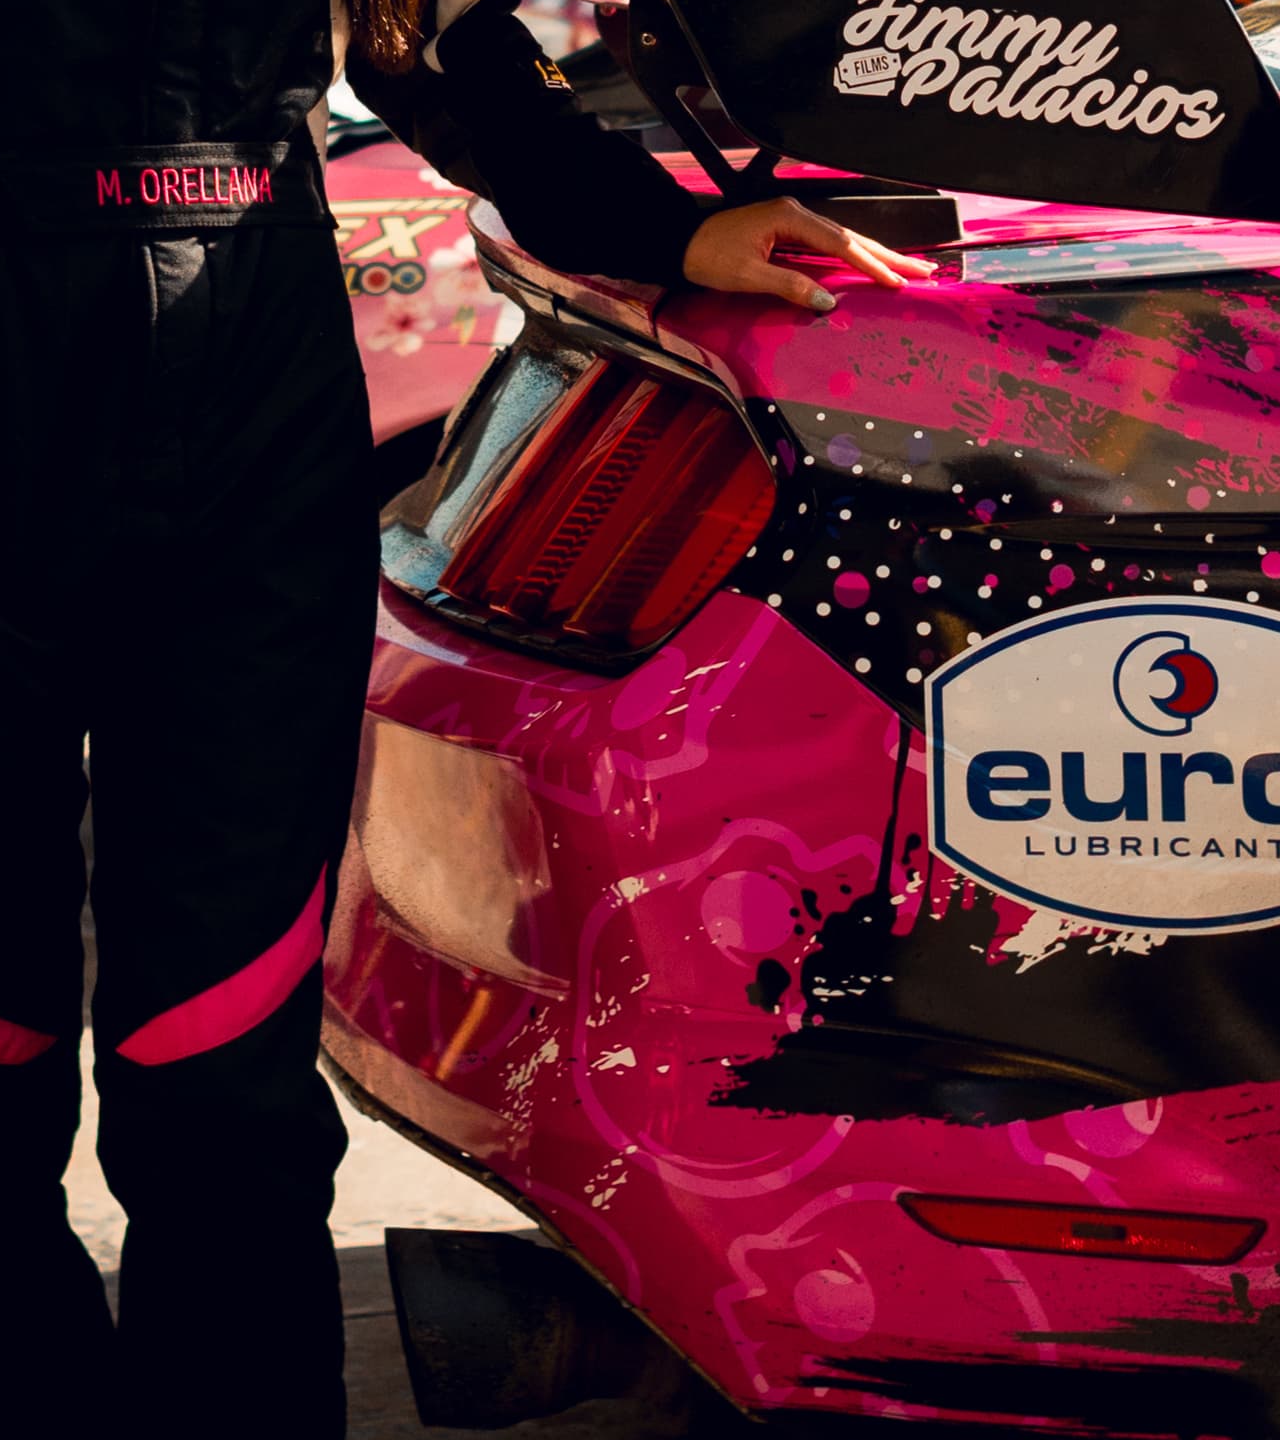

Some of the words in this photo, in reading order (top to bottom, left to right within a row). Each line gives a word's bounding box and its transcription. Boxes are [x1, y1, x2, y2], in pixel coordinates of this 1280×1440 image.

[854, 55, 890, 77] FILMS
[901, 44, 1225, 140] Palacios
[96, 168, 133, 207] M.
[139, 166, 274, 207] ORELLANA
